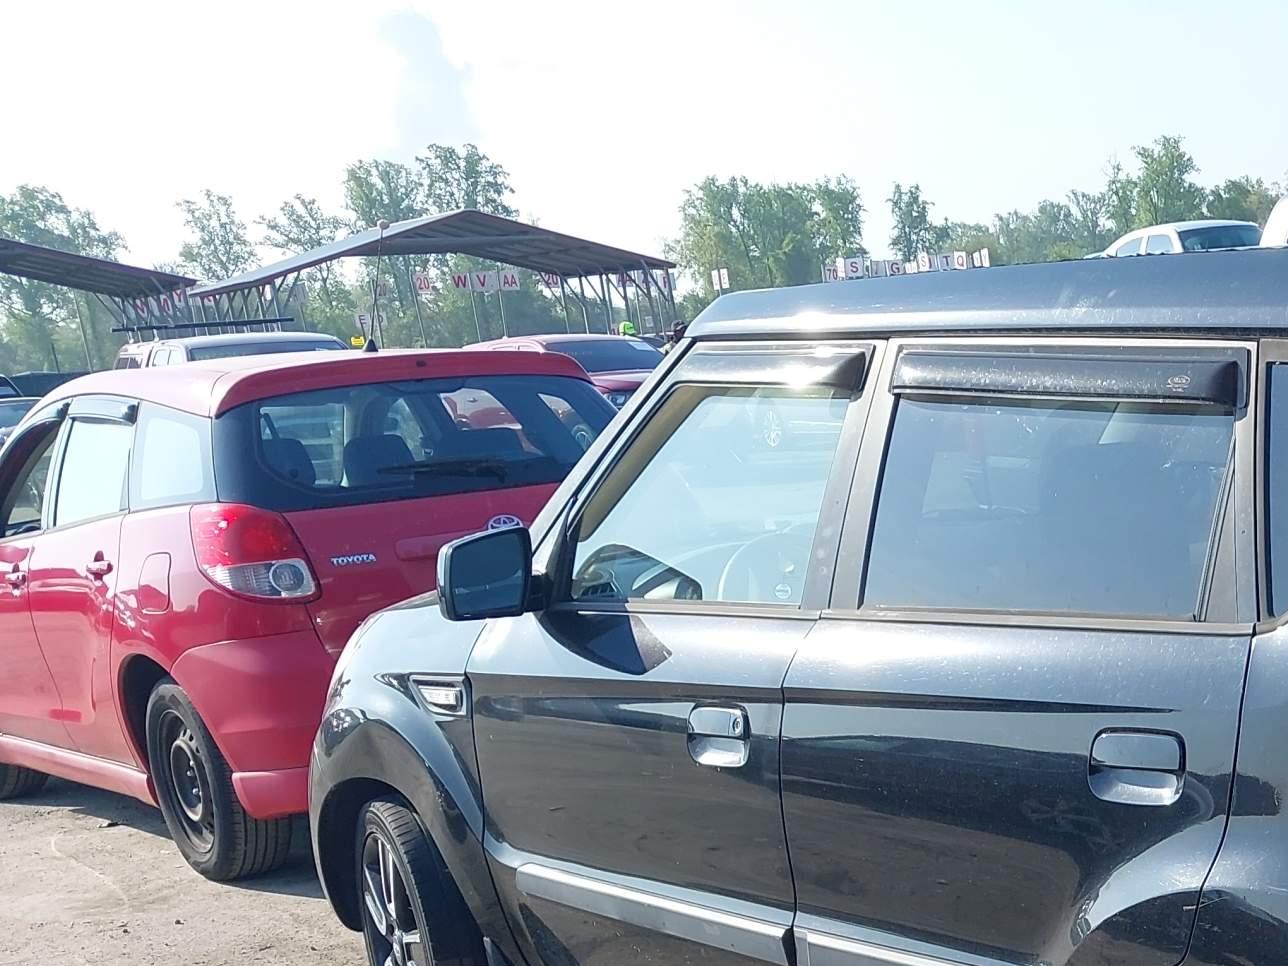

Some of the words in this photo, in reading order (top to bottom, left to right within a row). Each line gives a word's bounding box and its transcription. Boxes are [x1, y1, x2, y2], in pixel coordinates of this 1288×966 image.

[850, 261, 859, 274] S
[890, 262, 900, 273] G
[827, 268, 838, 280] 70
[416, 277, 430, 290] 20
[453, 276, 468, 288] W
[476, 275, 487, 287] V
[503, 275, 518, 287] AA
[330, 553, 377, 567] TOYOTA
